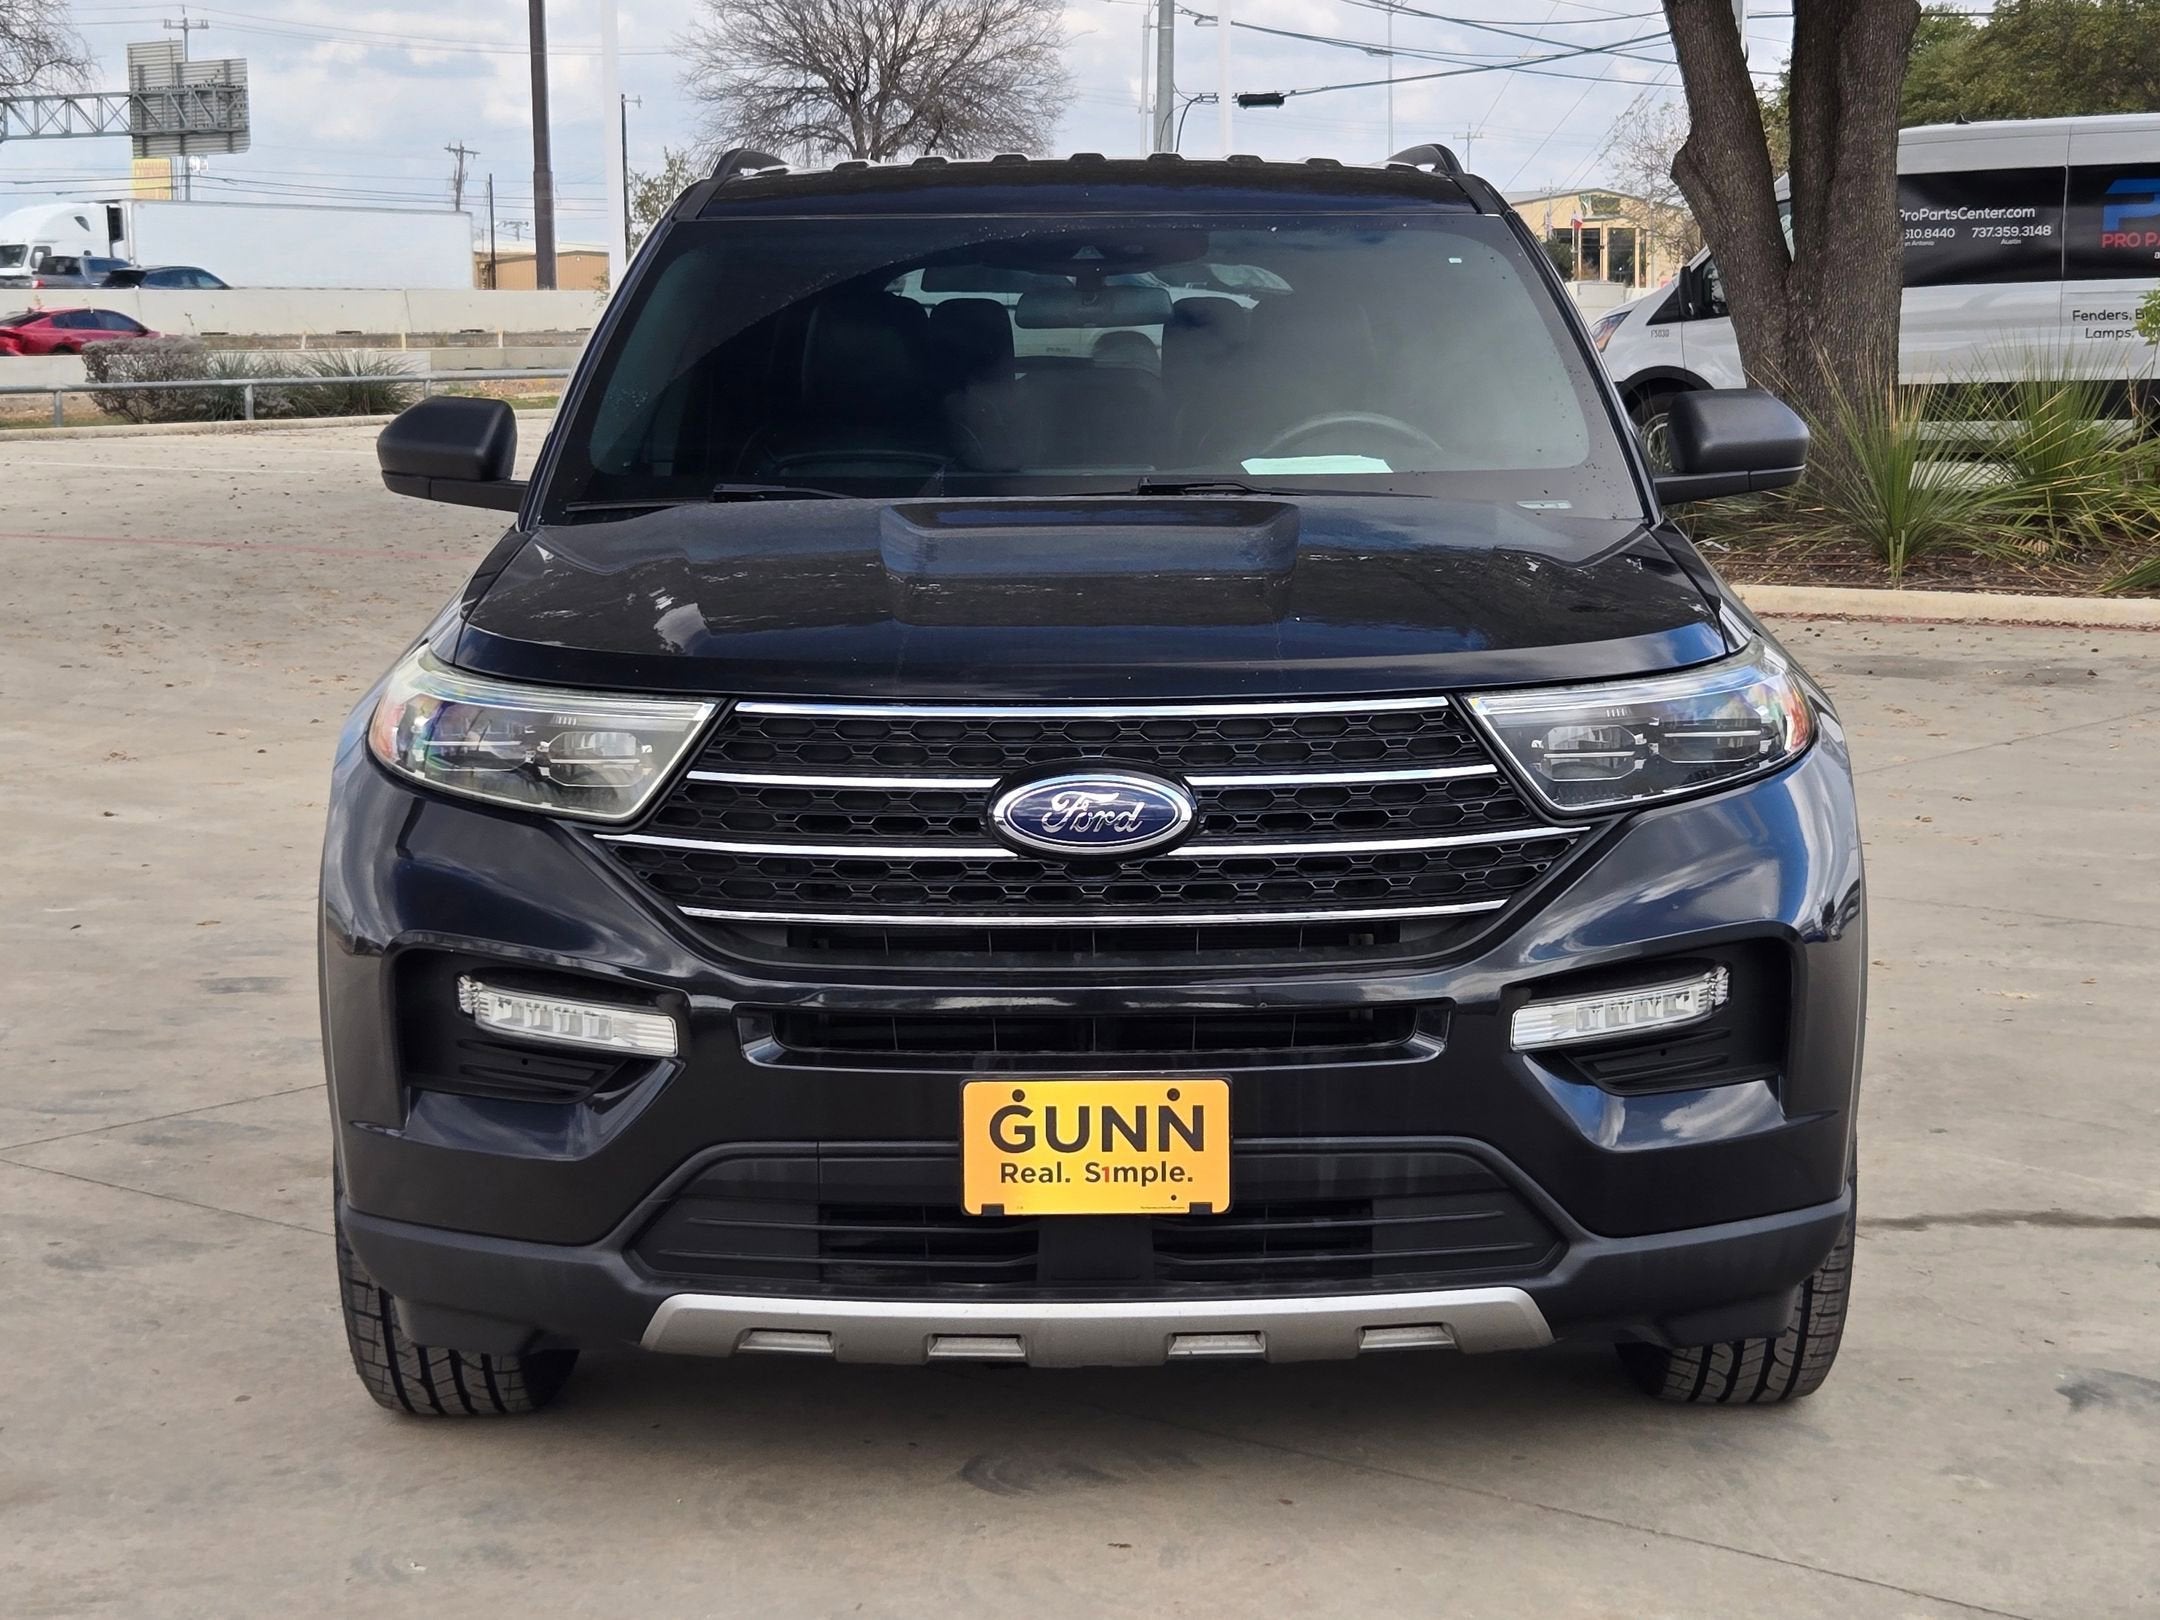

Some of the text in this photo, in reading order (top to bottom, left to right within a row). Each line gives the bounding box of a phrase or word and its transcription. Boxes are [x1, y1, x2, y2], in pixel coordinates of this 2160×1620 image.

[1900, 207, 2035, 221] ProPartsCenter.com
[1972, 225, 2052, 238] 737.359.3148
[2101, 232, 2141, 248] PRO
[1041, 791, 1146, 833] Ford
[989, 1104, 1205, 1154] GUNN
[1000, 1161, 1071, 1184] Real.
